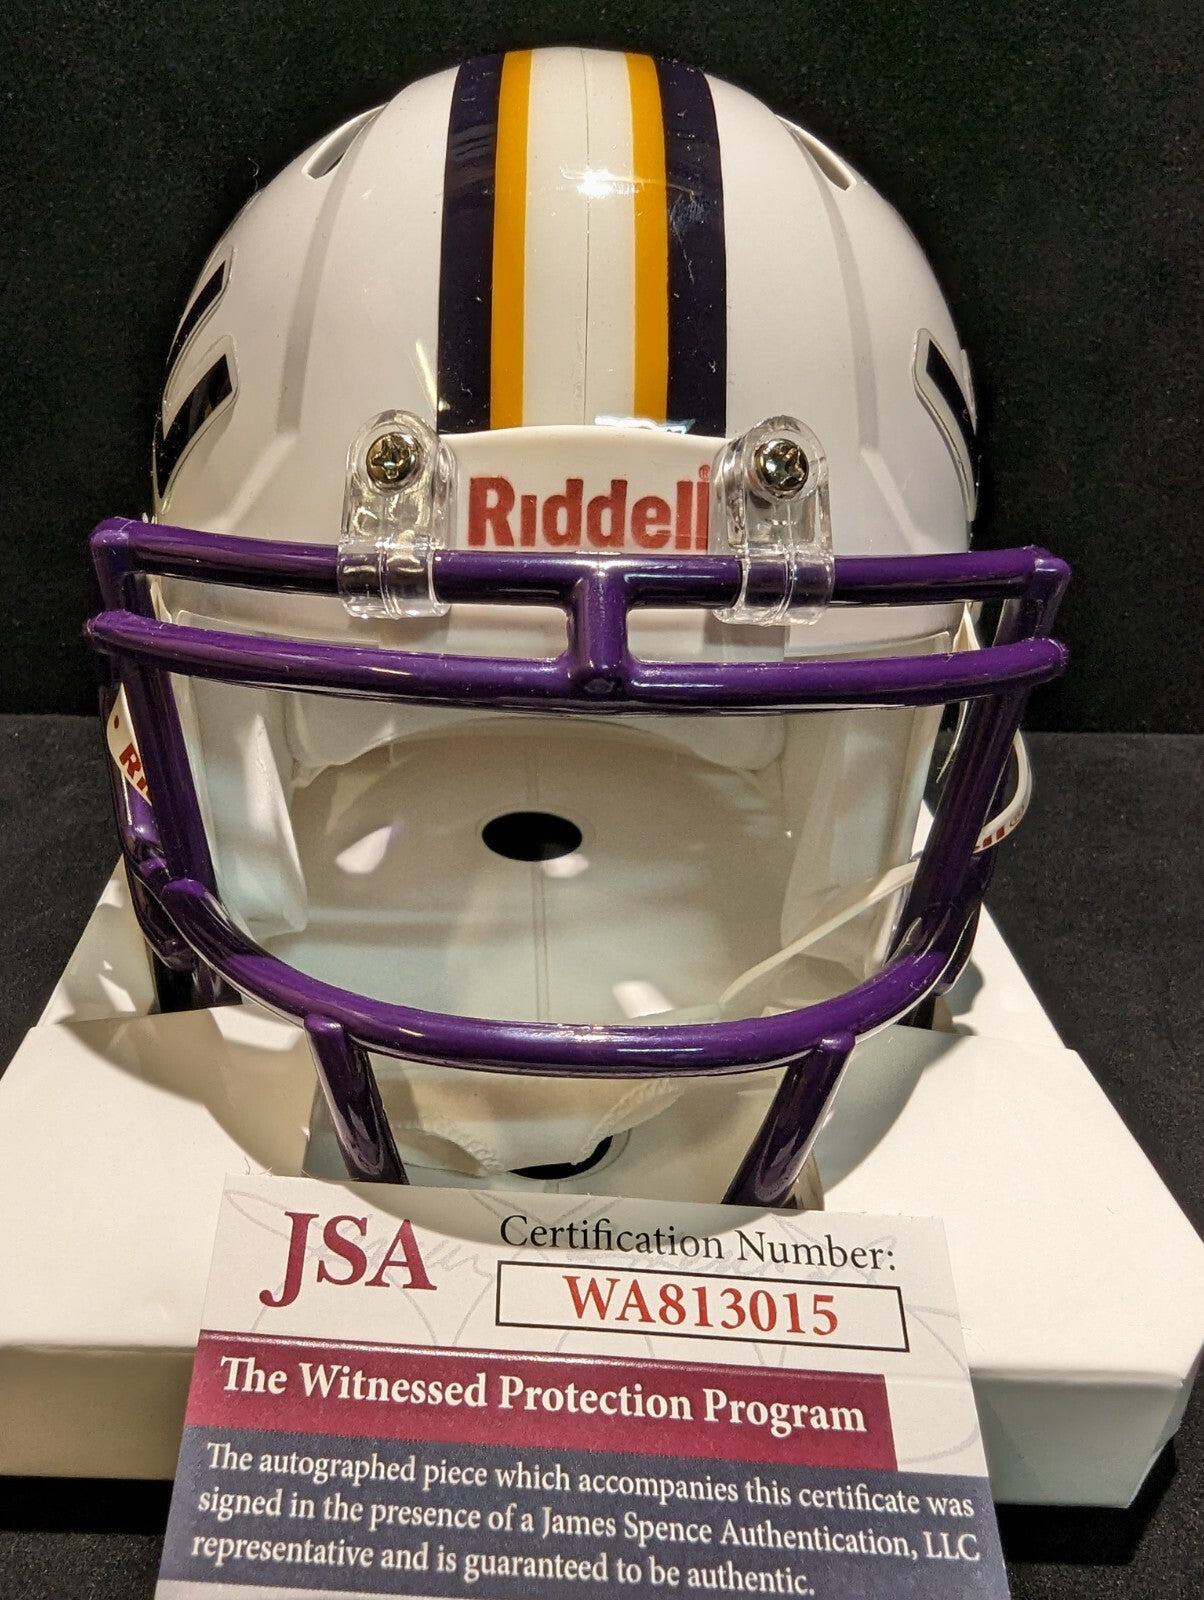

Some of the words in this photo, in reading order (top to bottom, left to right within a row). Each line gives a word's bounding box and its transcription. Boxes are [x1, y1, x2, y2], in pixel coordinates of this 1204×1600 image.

[259, 1211, 437, 1308] JSA
[501, 1215, 724, 1260] Certification
[734, 1229, 896, 1271] Number:
[562, 1275, 839, 1336] WA813015
[220, 1355, 287, 1395] The
[299, 1362, 488, 1408] Witnessed
[499, 1376, 693, 1421] Protection
[702, 1387, 867, 1438] Program
[206, 1442, 253, 1472] The
[260, 1453, 416, 1486] autographed
[423, 1459, 488, 1492] piece
[495, 1461, 571, 1491] which
[578, 1472, 739, 1505] accompanies
[744, 1476, 792, 1505] this
[798, 1484, 921, 1515] certificate
[926, 1494, 975, 1517] was
[198, 1486, 282, 1523] signed
[289, 1491, 315, 1519] in
[323, 1493, 364, 1522] the
[369, 1502, 481, 1532] presence
[488, 1503, 516, 1532] of
[521, 1512, 535, 1533] a
[541, 1506, 617, 1539] James
[624, 1511, 712, 1548] Spence
[720, 1519, 919, 1561] Authentication,
[923, 1530, 981, 1562] LLC
[191, 1533, 374, 1568] representative
[381, 1541, 429, 1572] and
[437, 1544, 457, 1572] is
[464, 1553, 608, 1583] guaranteed
[616, 1558, 642, 1585] to
[649, 1556, 680, 1586] be
[688, 1560, 816, 1596] authentic.
